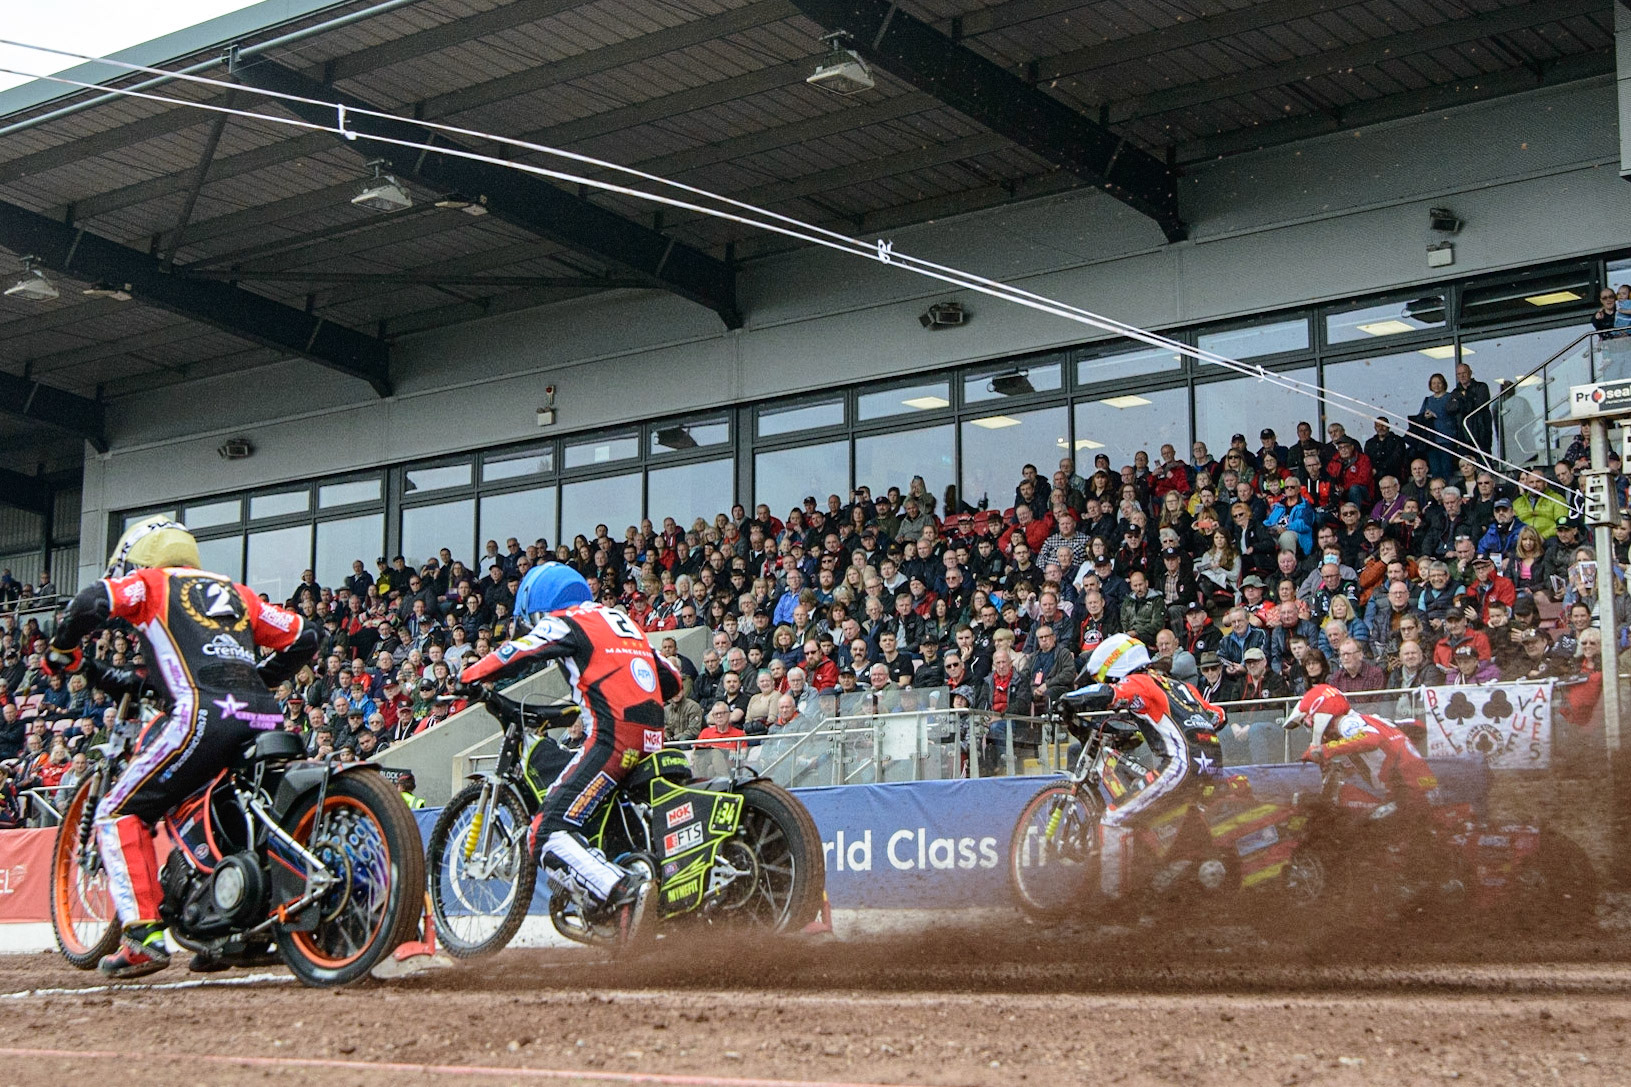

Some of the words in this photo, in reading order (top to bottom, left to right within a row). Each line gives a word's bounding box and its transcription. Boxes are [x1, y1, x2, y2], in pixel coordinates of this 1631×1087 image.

[206, 582, 239, 617] 2
[608, 611, 635, 635] 2
[645, 733, 661, 745] NGK
[668, 804, 692, 822] NGK
[677, 823, 702, 845] FTS
[822, 830, 872, 872] rld
[887, 828, 999, 870] Class
